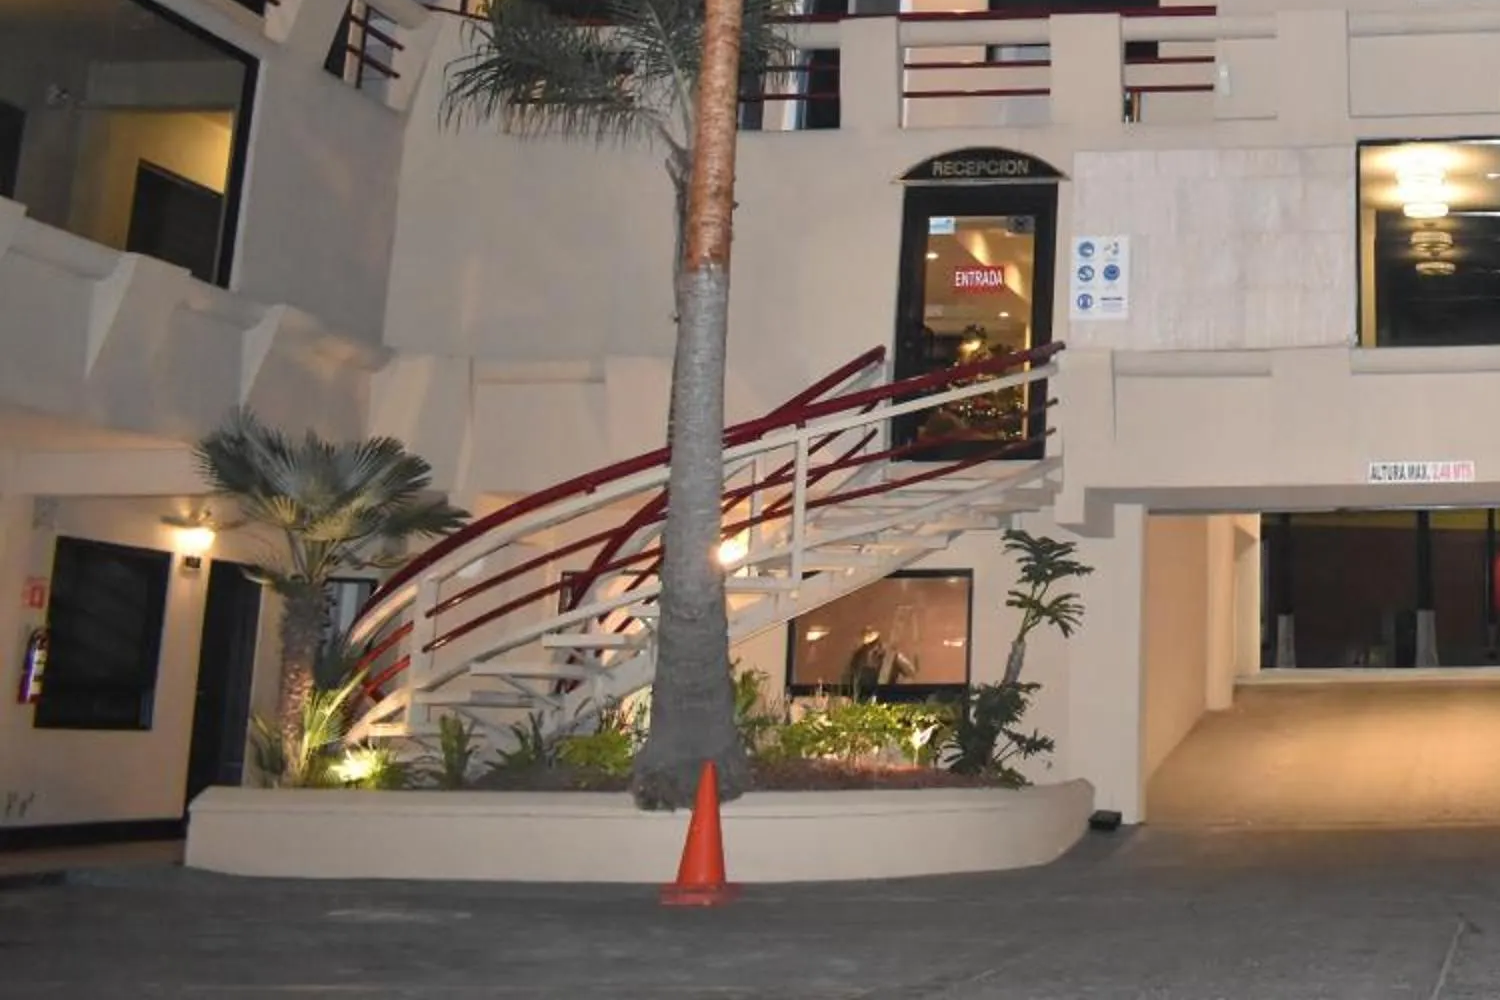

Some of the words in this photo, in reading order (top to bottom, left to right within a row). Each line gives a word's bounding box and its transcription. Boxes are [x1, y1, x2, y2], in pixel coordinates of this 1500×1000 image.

[932, 160, 1029, 177] RECEPCION
[955, 269, 1003, 287] ENTRADA
[1371, 463, 1405, 481] ALTURA
